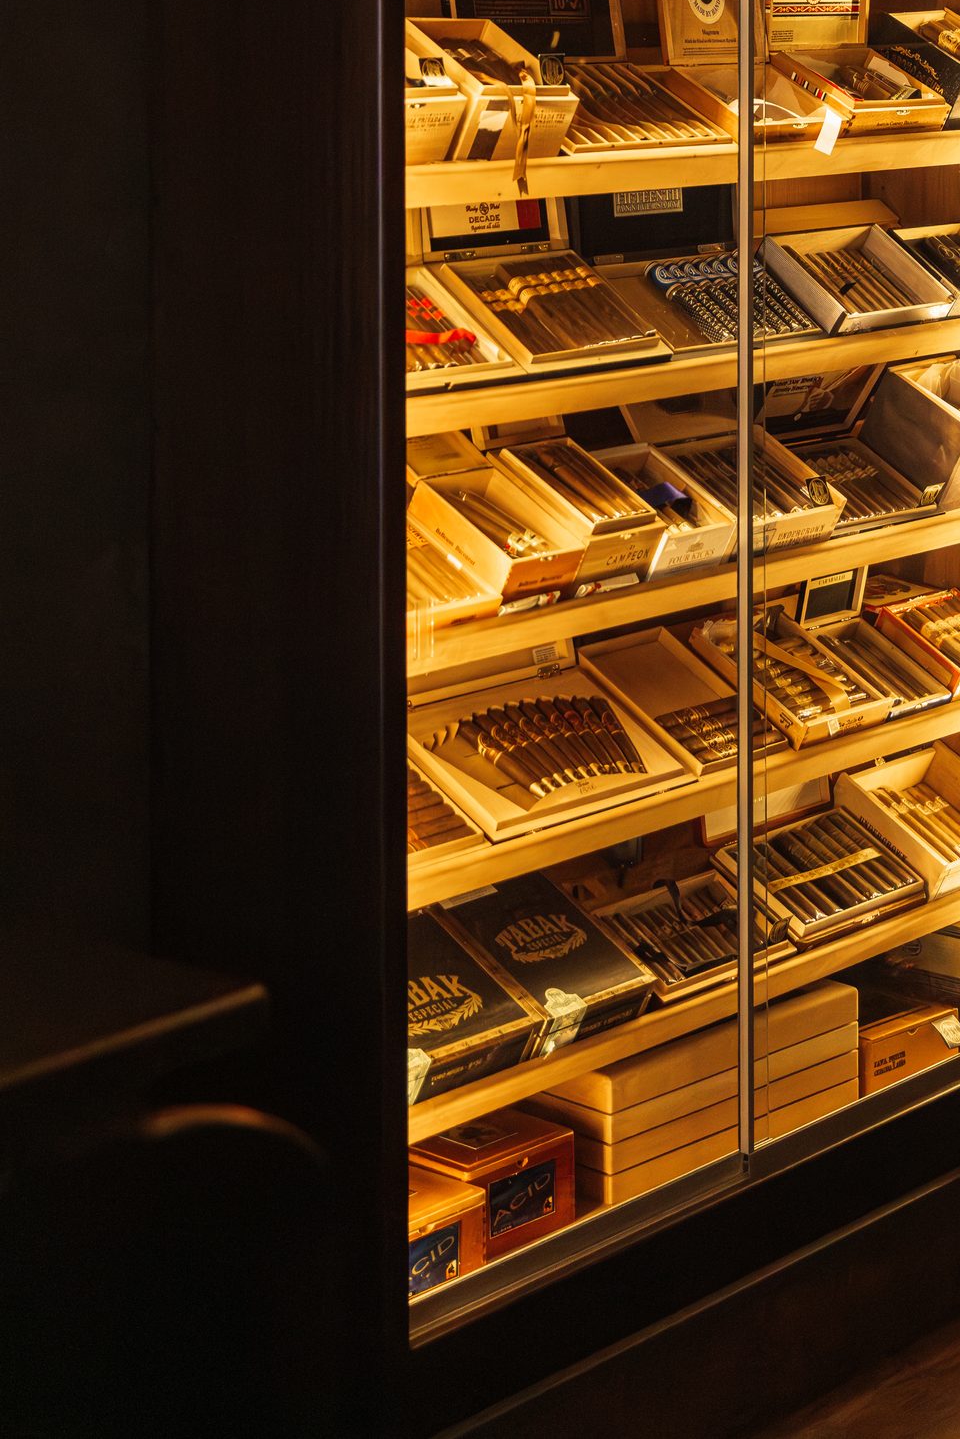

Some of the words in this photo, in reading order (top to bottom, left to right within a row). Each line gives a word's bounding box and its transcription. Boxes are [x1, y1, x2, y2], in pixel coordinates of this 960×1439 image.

[616, 188, 680, 204] FIFTEENTH
[468, 214, 501, 224] DECADE
[605, 547, 650, 566] CAMPEON
[667, 554, 690, 565] FOUR
[691, 548, 716, 562] KICKS
[859, 816, 907, 861] UNDERCROWN
[495, 913, 579, 955] TABAK
[526, 932, 570, 950] ESPECIAL
[407, 974, 466, 1011] BAK
[409, 998, 458, 1023] ESPECIAL
[493, 1172, 551, 1228] ACID
[408, 1235, 456, 1281] CID
